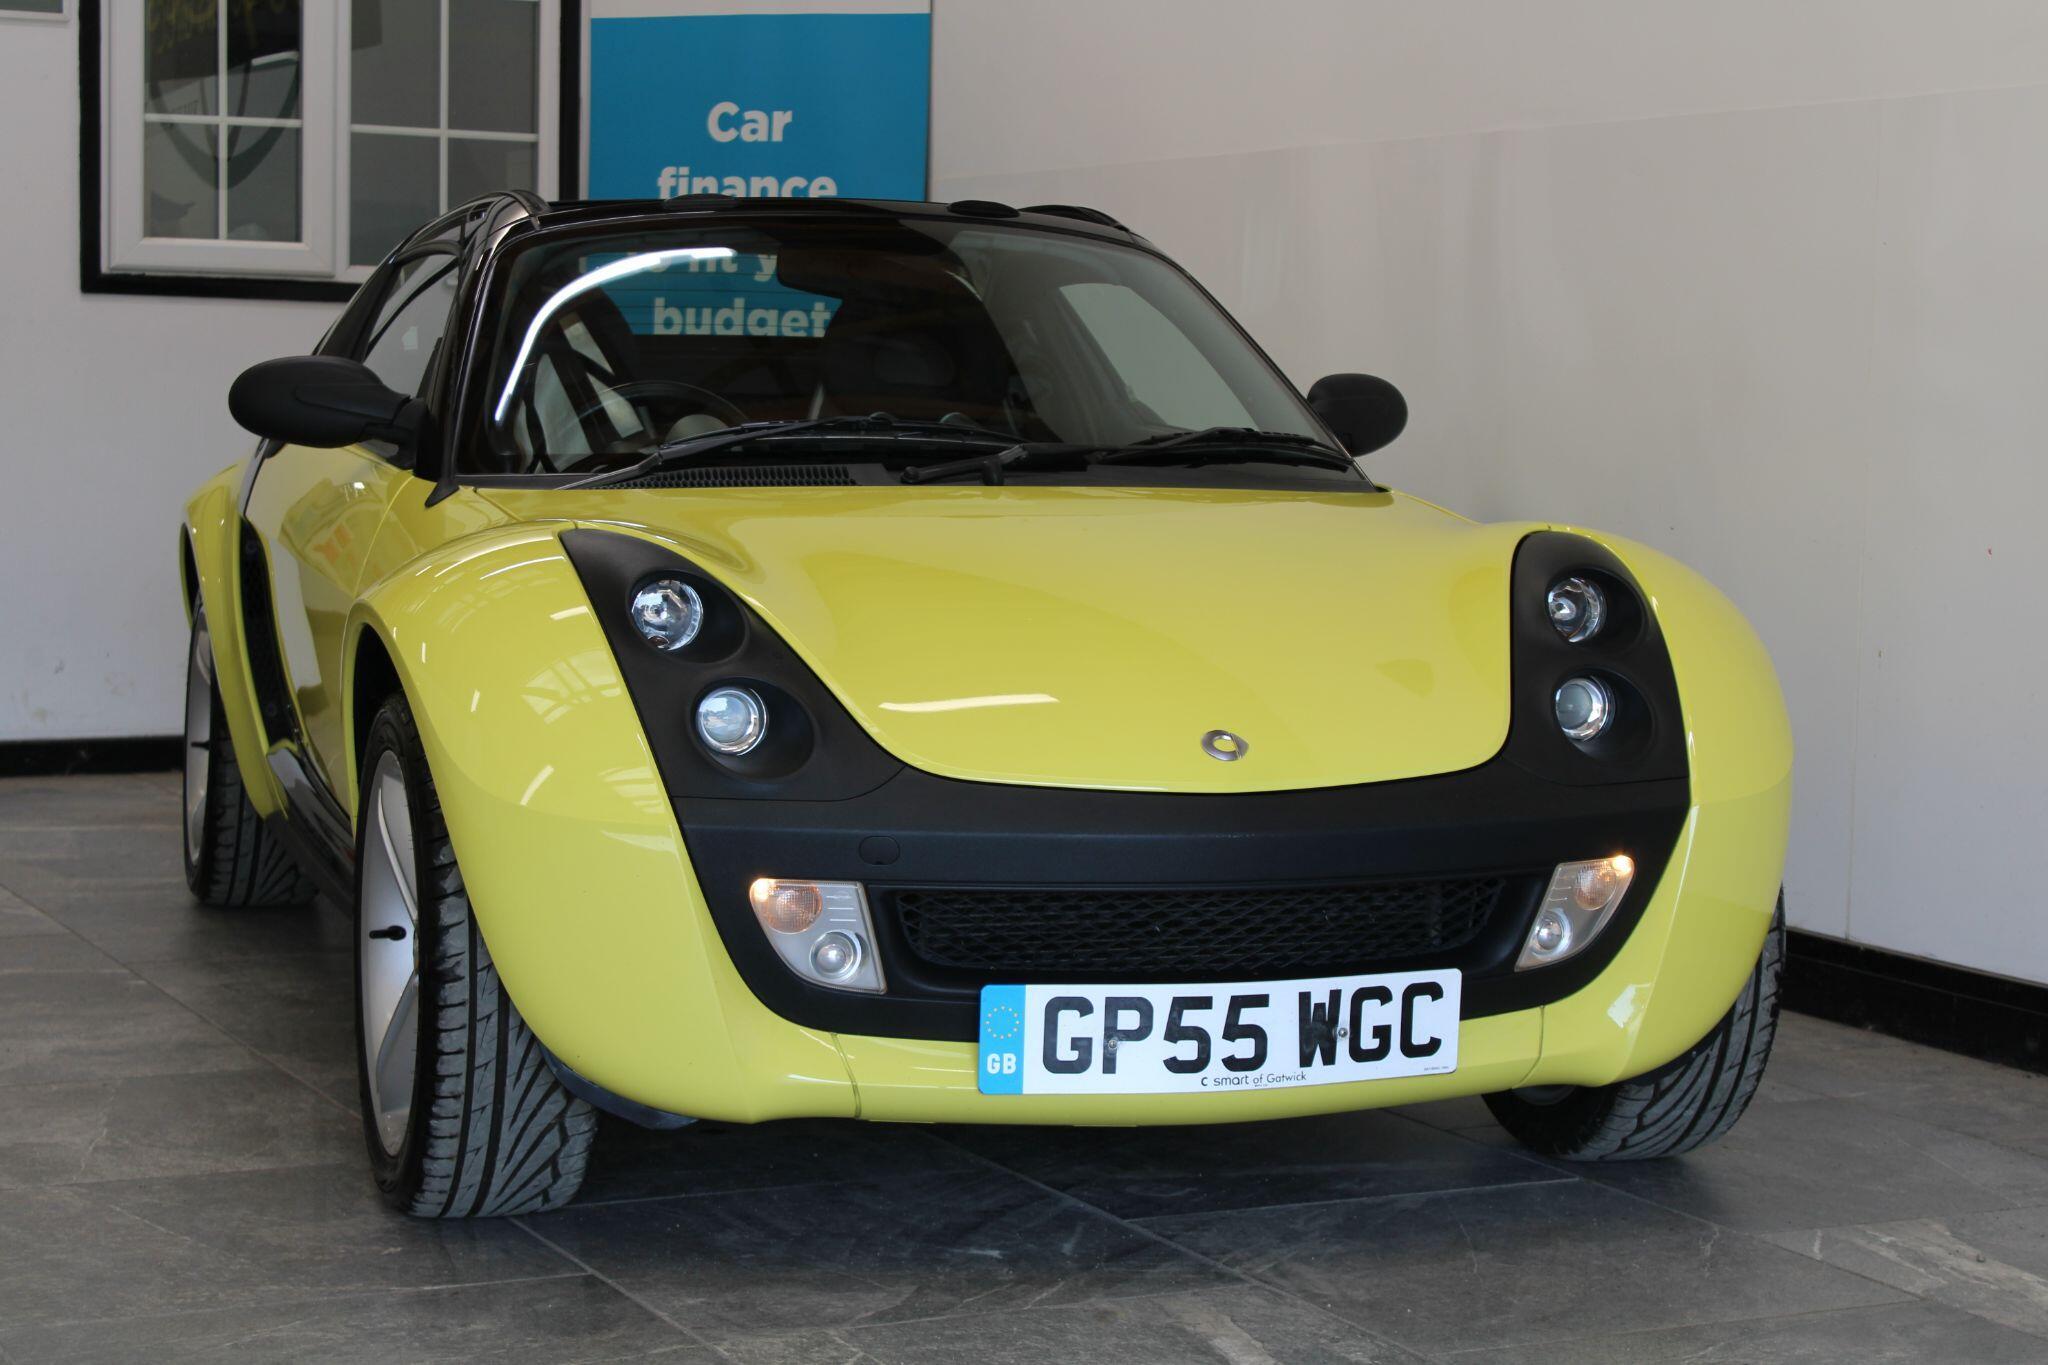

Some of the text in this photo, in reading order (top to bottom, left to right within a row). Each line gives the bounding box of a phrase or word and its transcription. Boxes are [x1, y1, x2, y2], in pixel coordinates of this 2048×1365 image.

[707, 101, 793, 142] Car
[657, 167, 838, 198] finance
[654, 298, 831, 337] budget
[1042, 981, 1444, 1074] GP55 WGC
[987, 1053, 1016, 1075] GB
[1213, 1074, 1249, 1086] smart
[1252, 1074, 1263, 1084] of
[1266, 1071, 1306, 1083] Gatwick
